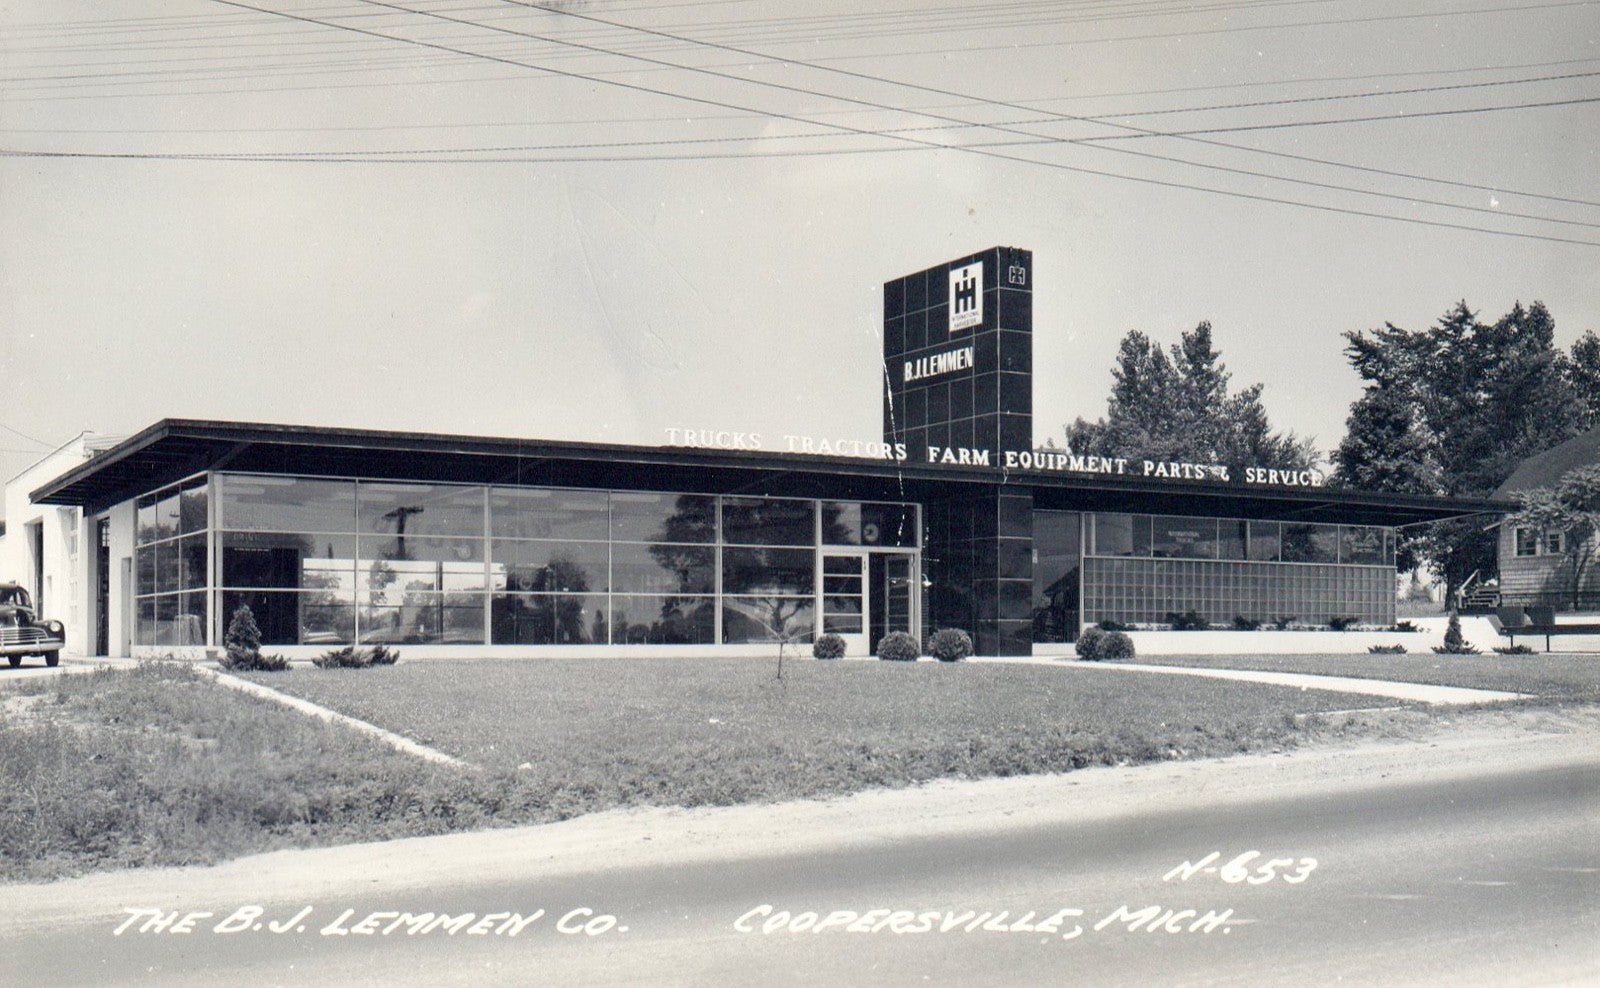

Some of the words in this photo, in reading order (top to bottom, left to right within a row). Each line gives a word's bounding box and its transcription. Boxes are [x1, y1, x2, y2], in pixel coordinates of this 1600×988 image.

[664, 427, 762, 450] TRUCKS
[784, 434, 908, 462] TRACTORS
[928, 446, 990, 467] FARM
[1005, 450, 1127, 475] EQUIPMENT
[1143, 460, 1205, 480] PARTS
[1219, 466, 1230, 481] &
[1245, 467, 1323, 487] SERVICE
